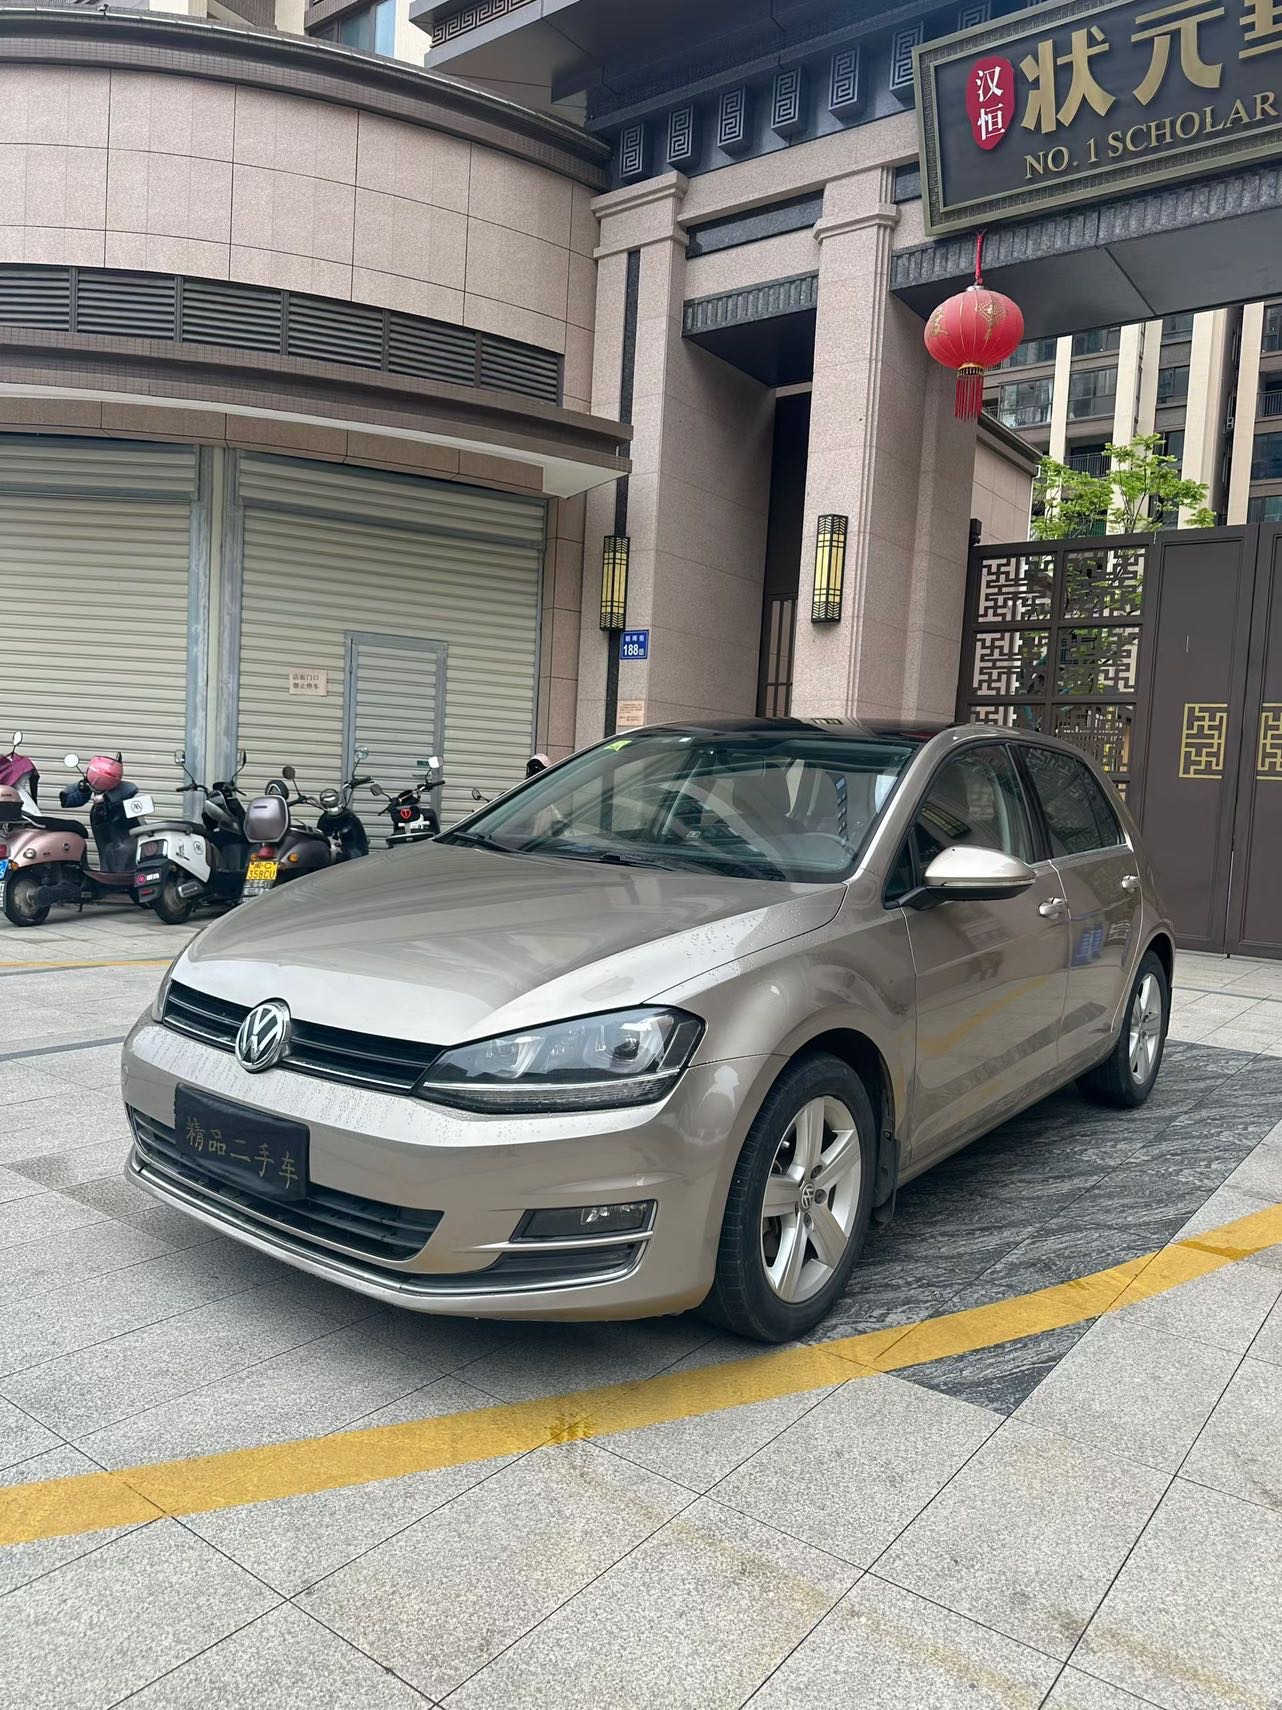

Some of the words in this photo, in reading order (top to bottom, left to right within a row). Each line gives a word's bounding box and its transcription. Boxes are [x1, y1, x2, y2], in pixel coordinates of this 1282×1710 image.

[975, 66, 1006, 141] 汉恒
[1107, 91, 1280, 159] SCHOLAR
[185, 1116, 298, 1190] 精品二手车
